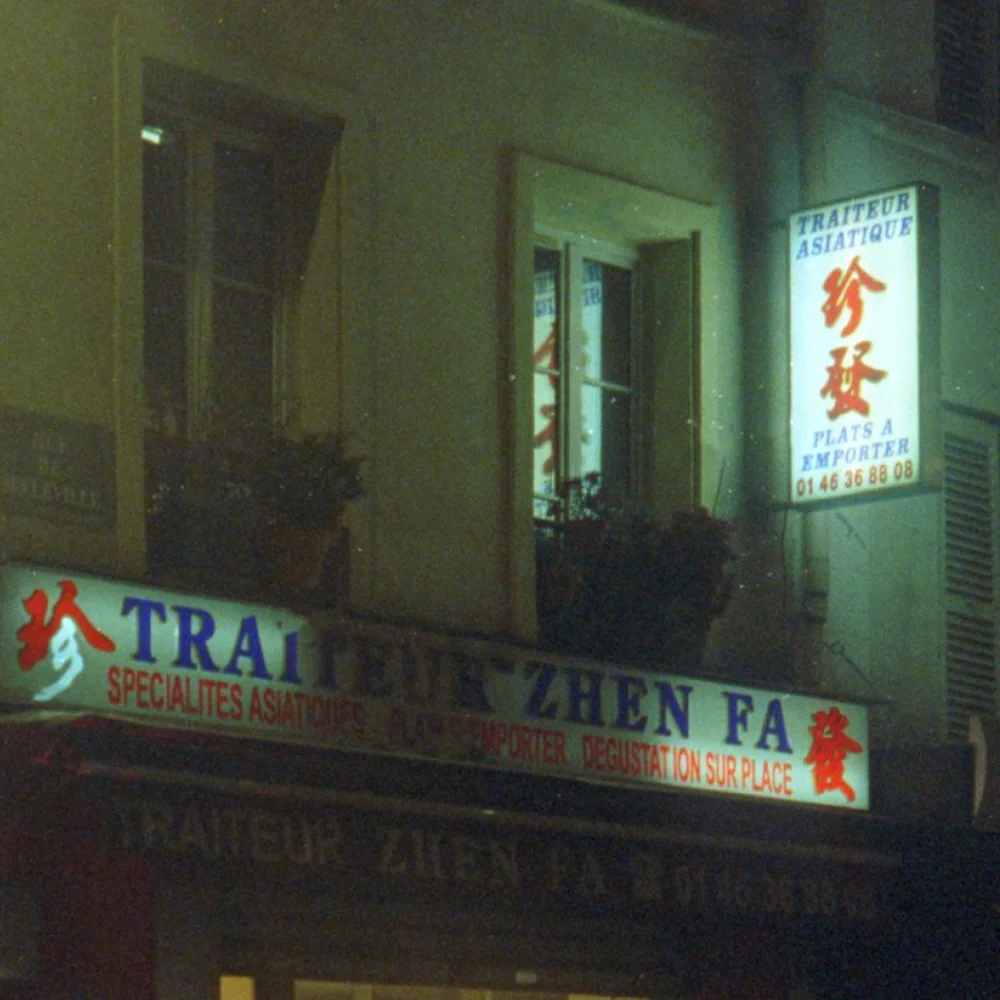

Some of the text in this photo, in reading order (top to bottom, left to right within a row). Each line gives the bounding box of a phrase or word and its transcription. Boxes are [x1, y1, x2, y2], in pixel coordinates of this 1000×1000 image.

[797, 192, 911, 236] TRAITEUR
[796, 216, 913, 260] ASIATIQUE
[813, 418, 894, 448] PLATS A
[797, 459, 913, 496] 01 46 36 88 08
[801, 438, 910, 473] EMPORTER
[524, 660, 694, 739] ZHEN
[722, 691, 793, 753] FA
[108, 668, 243, 722] SPECIALITES
[583, 735, 701, 786] DEGUSTATION
[705, 751, 738, 789] SUR
[741, 756, 793, 796] PLACE
